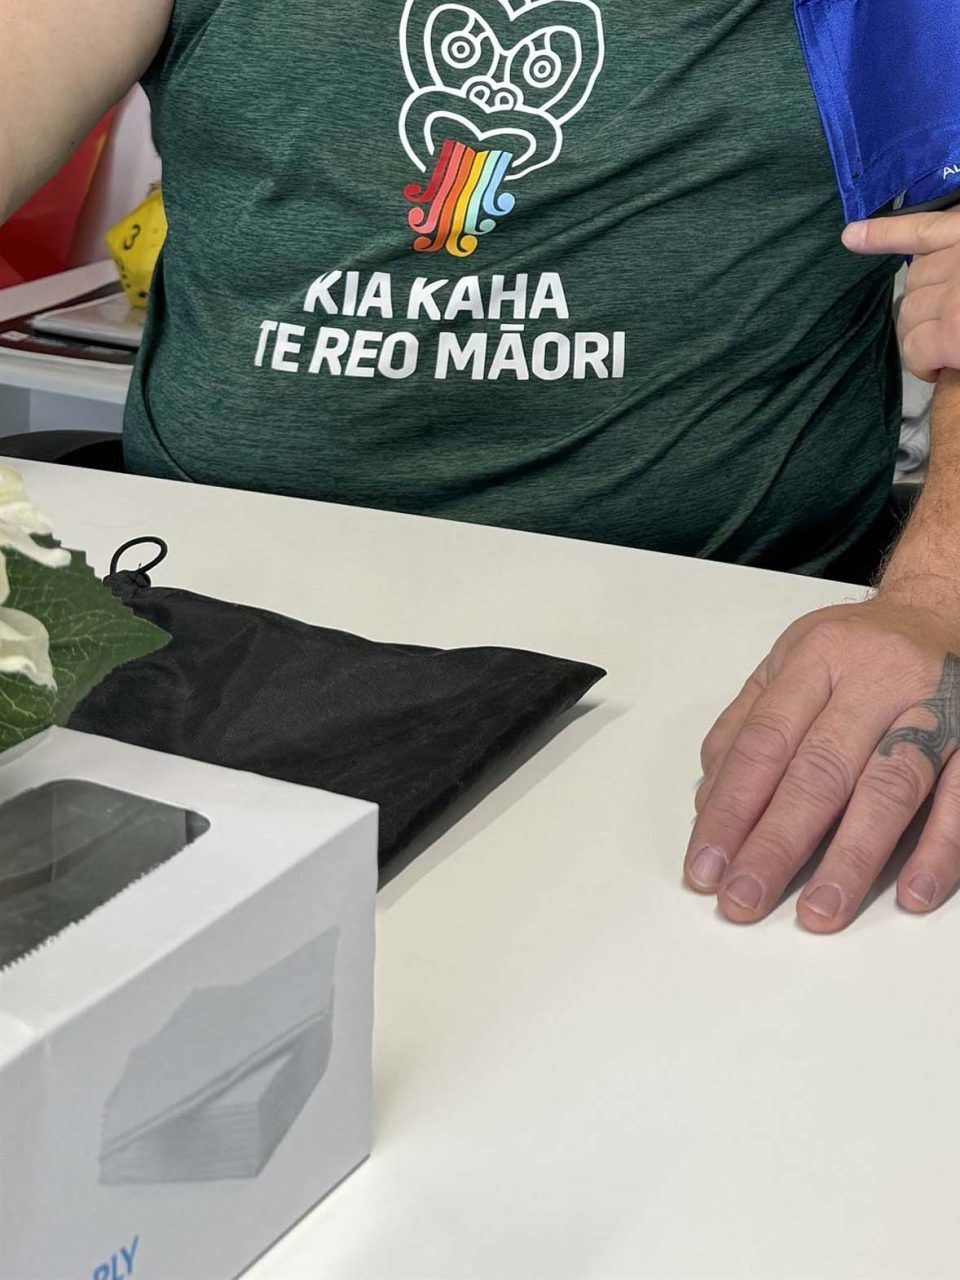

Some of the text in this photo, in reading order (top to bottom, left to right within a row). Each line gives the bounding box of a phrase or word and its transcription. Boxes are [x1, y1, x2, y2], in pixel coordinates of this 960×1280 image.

[303, 270, 570, 320] KIA KAHA
[254, 320, 626, 380] TE REO MĀORI
